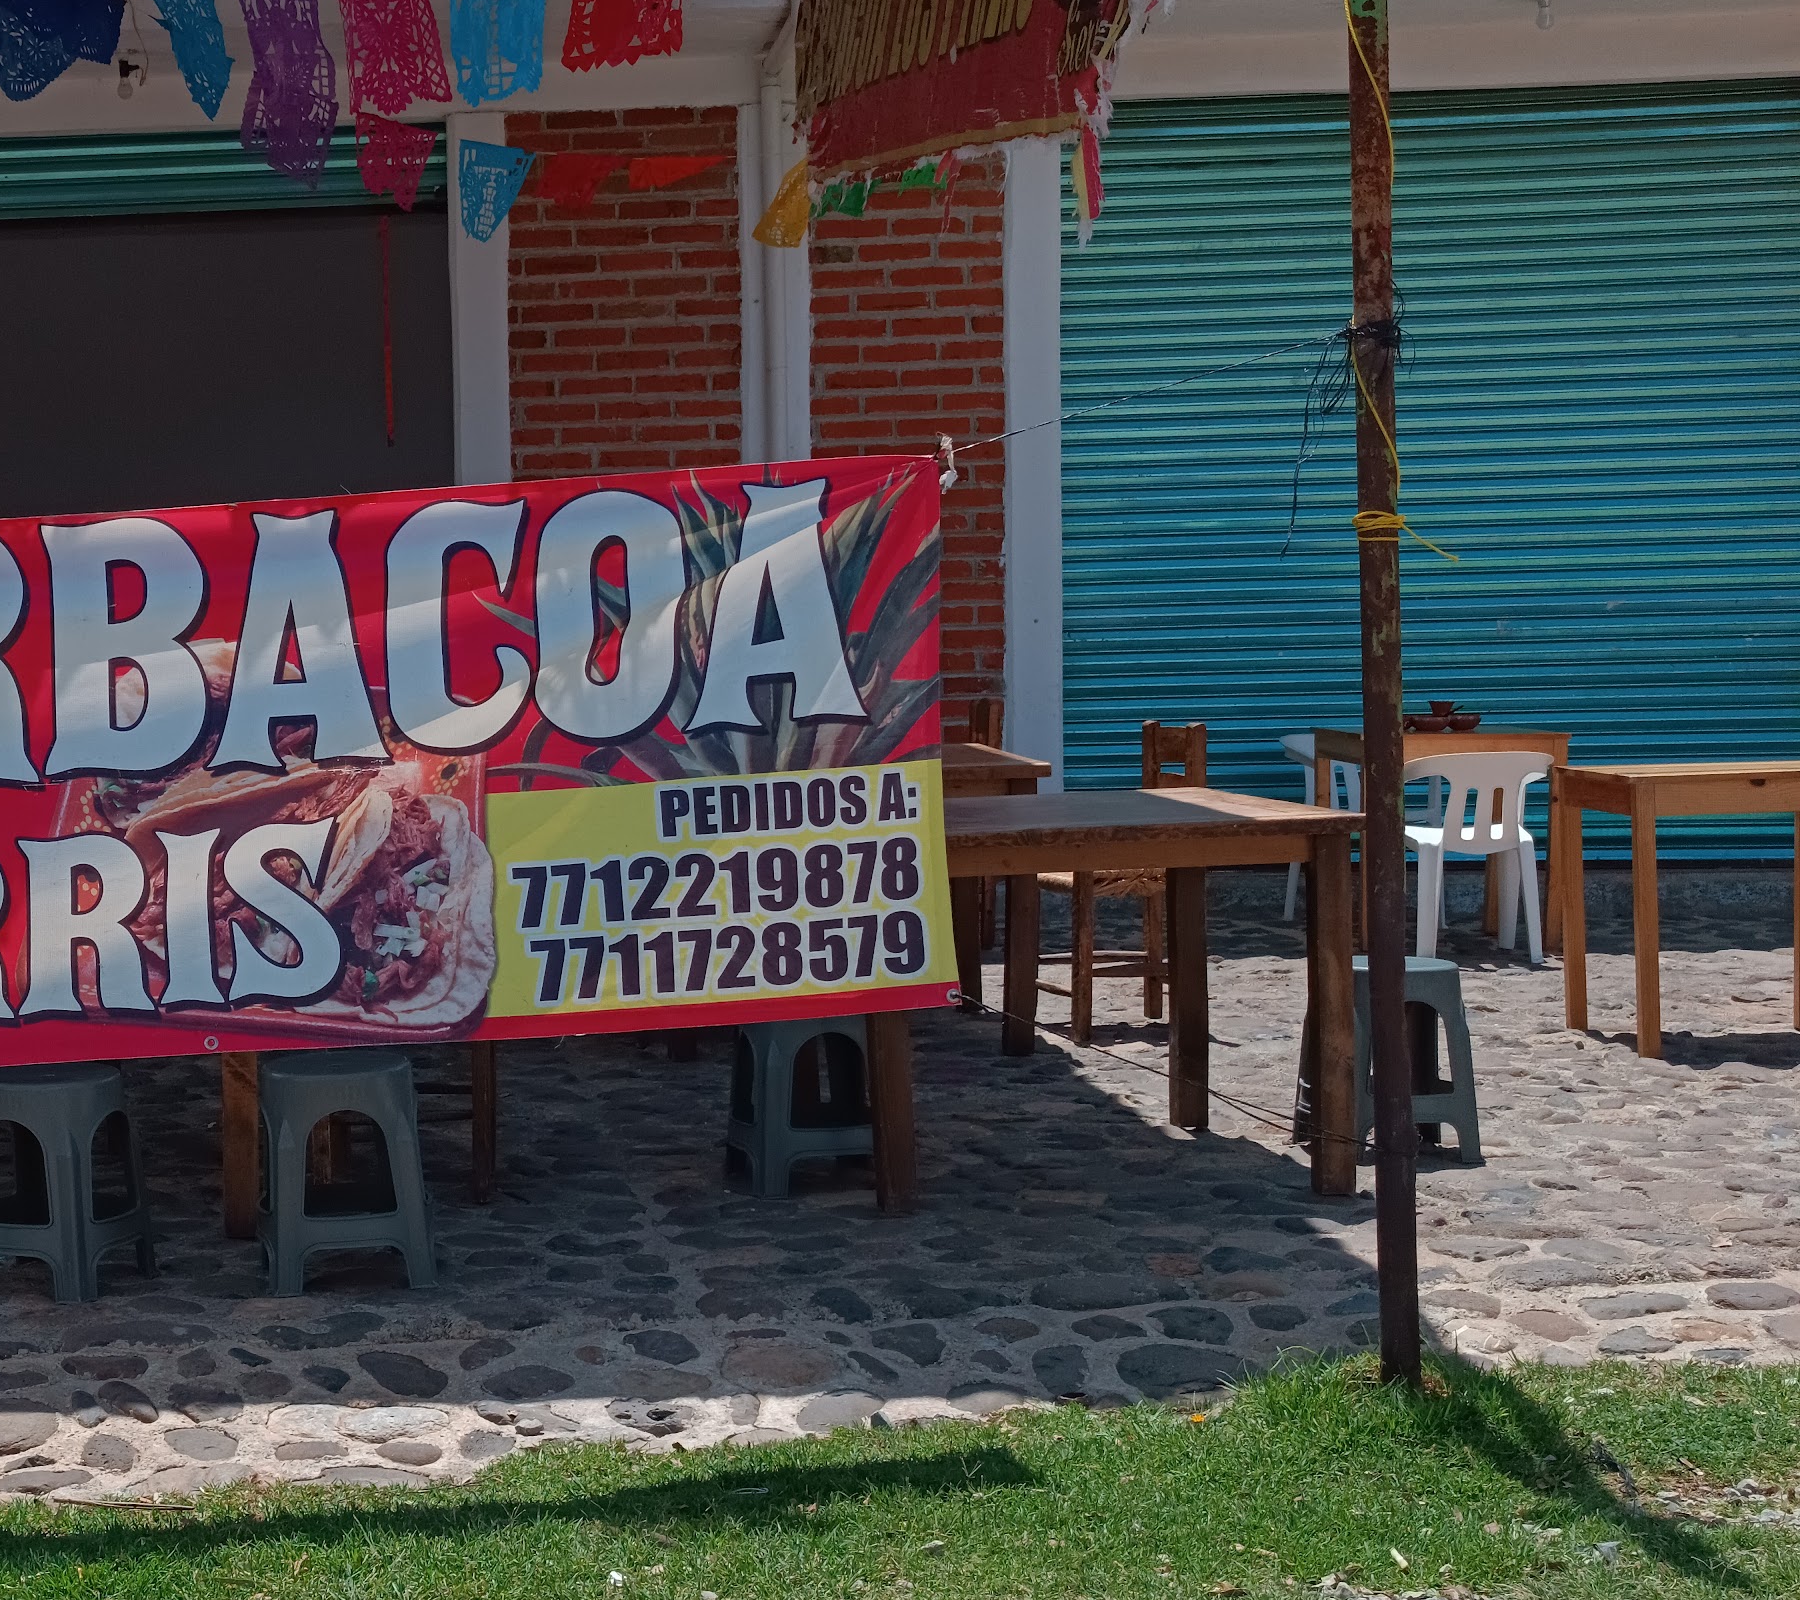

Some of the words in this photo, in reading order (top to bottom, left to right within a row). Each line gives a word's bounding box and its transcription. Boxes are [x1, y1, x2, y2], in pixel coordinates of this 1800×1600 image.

[660, 775, 869, 838] PEDIDOS
[876, 773, 919, 823] A:
[512, 836, 921, 930] 7712219878
[530, 910, 926, 1002] 7711728579
